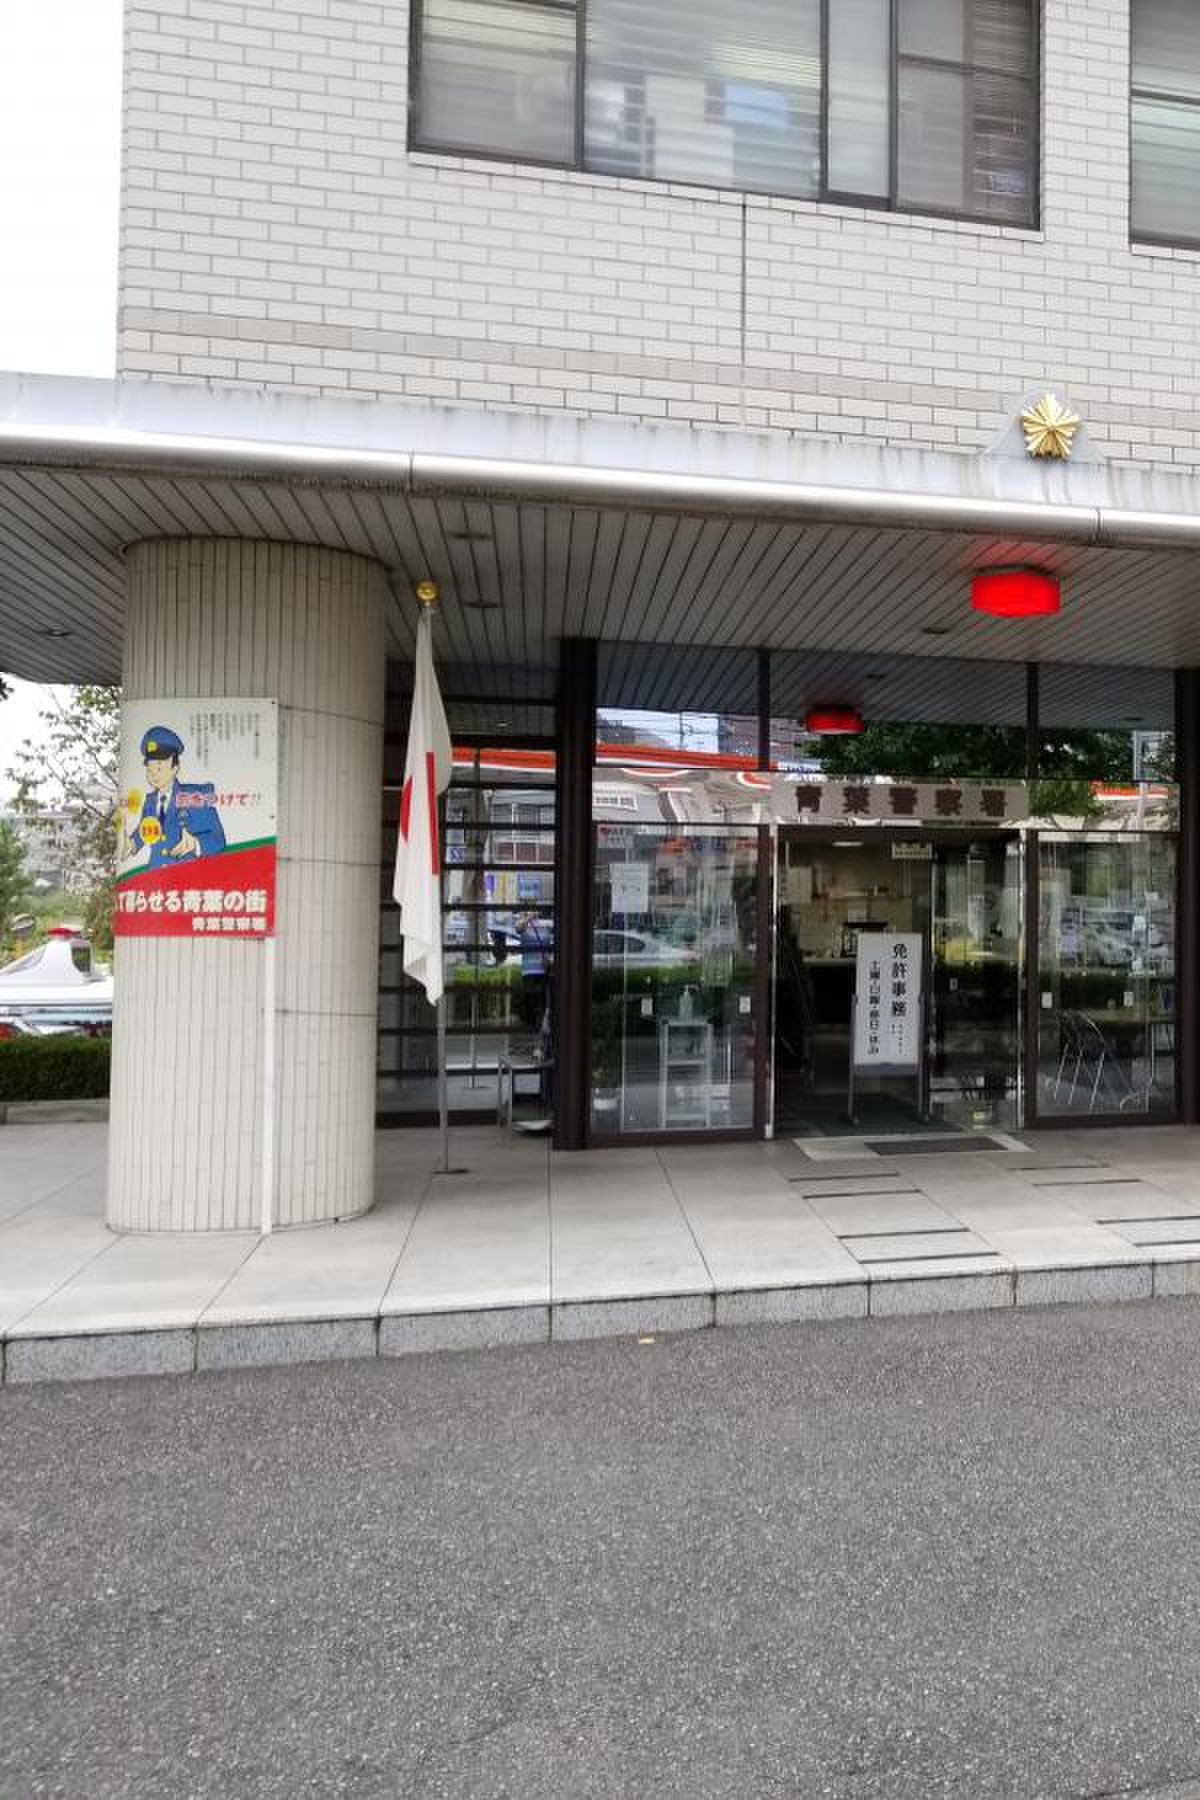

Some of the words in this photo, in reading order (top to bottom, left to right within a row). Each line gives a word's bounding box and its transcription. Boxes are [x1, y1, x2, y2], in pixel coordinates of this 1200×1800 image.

[795, 785, 1005, 816] 青葉警察署
